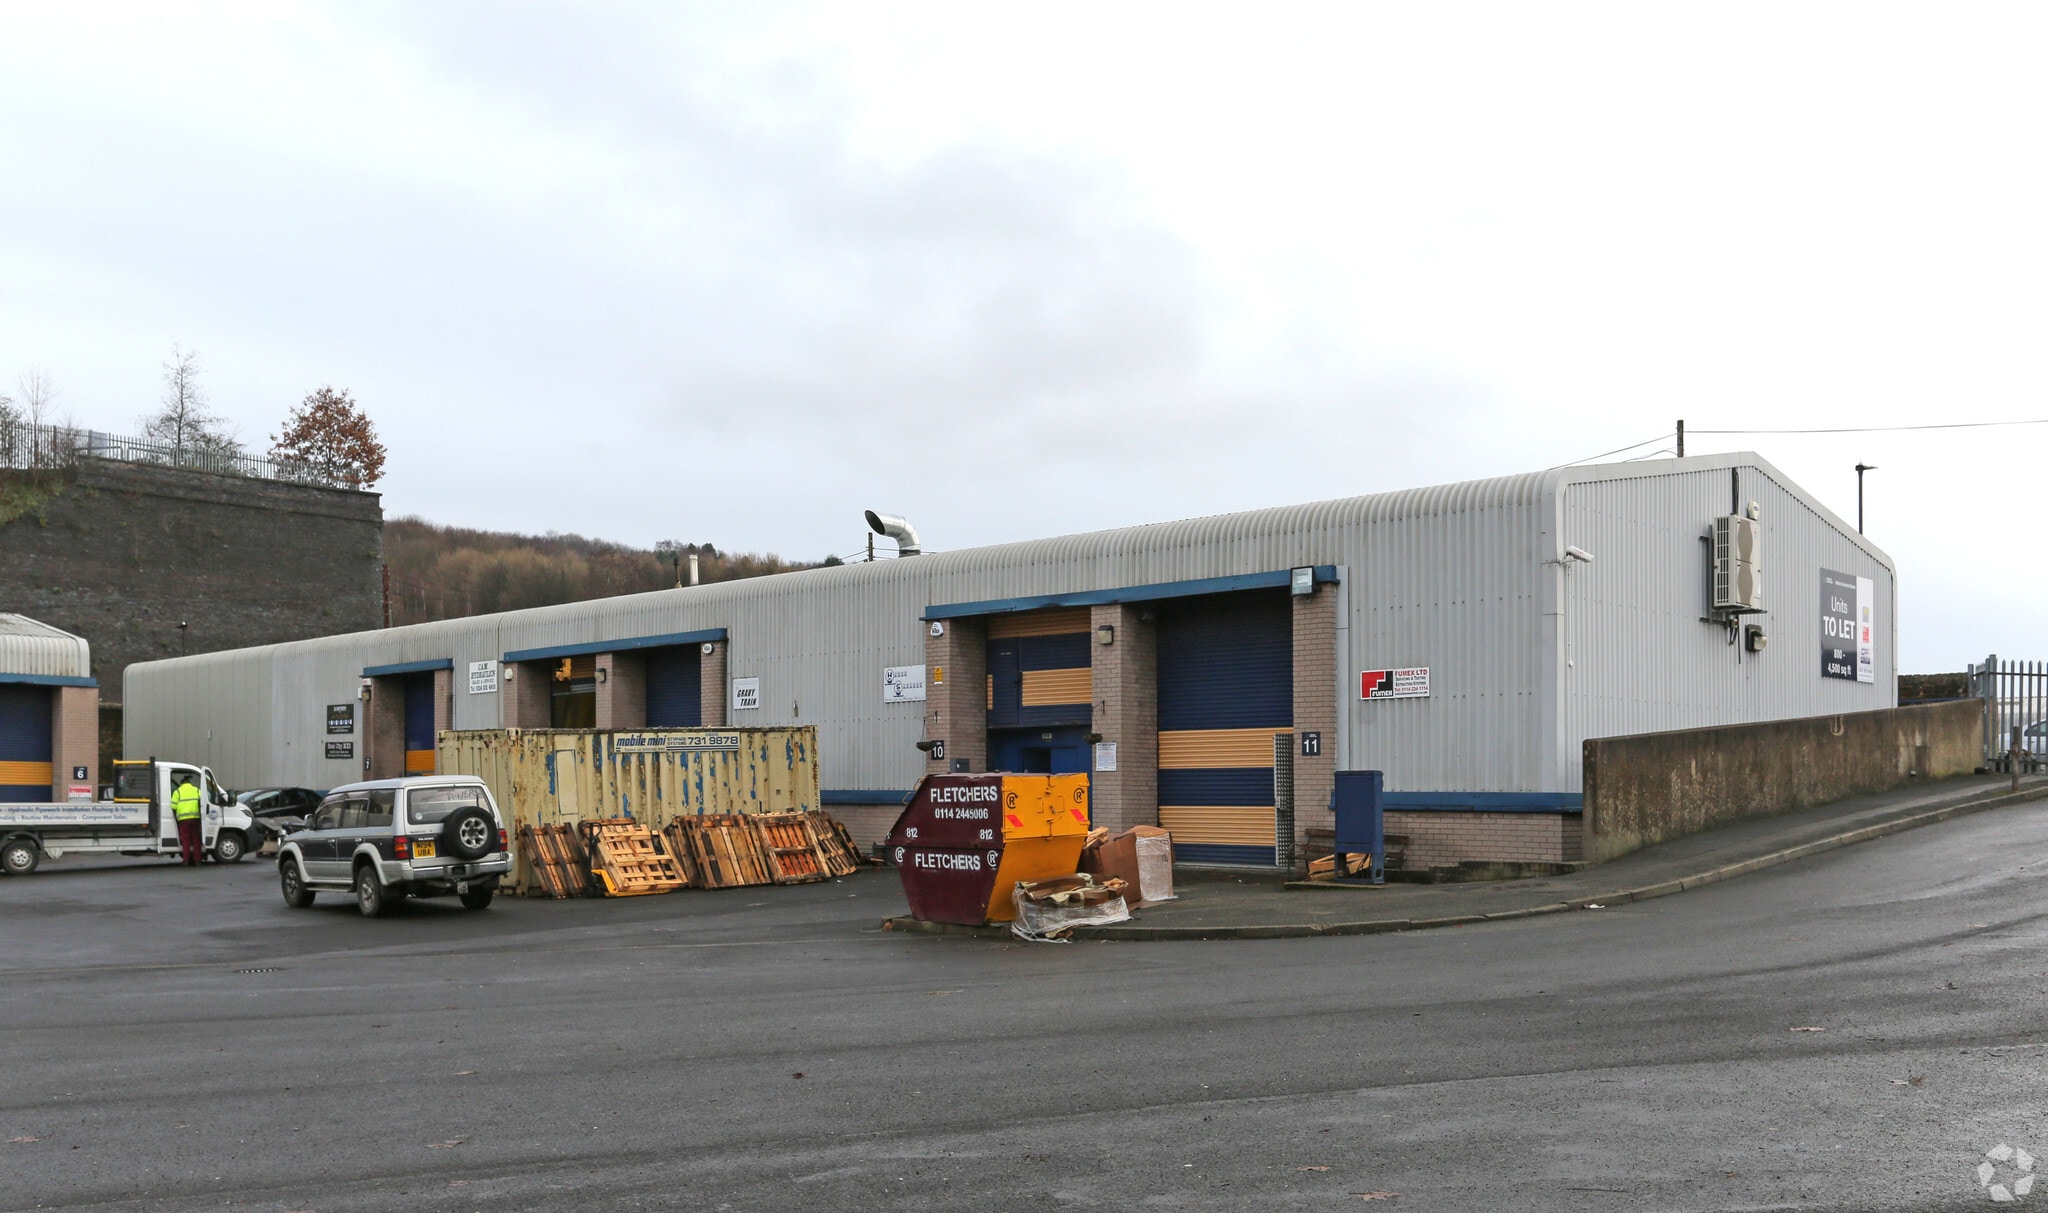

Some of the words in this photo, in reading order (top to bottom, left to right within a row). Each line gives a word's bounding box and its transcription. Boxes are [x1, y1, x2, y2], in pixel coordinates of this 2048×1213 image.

[1831, 595, 1848, 614] Units
[1823, 615, 1837, 637] TO
[1839, 618, 1856, 640] LET
[1841, 665, 1847, 676] sq
[1847, 665, 1852, 675] ft
[737, 689, 756, 697] GRAVY
[740, 698, 757, 707] TRAIN
[616, 734, 646, 747] mobile
[647, 734, 667, 746] mini
[687, 737, 706, 745] 731
[709, 736, 739, 745] 9878
[1303, 739, 1317, 753] 11
[932, 746, 943, 758] 10
[77, 770, 84, 778] 6
[930, 785, 998, 803] FLETCHERS
[120, 806, 138, 814] Testing
[935, 808, 954, 819] 0114
[956, 808, 989, 820] 2445006
[82, 814, 112, 822] Component
[906, 827, 918, 838] 812
[980, 829, 993, 840] 812
[417, 848, 432, 857] UBA
[915, 853, 981, 871] FLETCHERS
